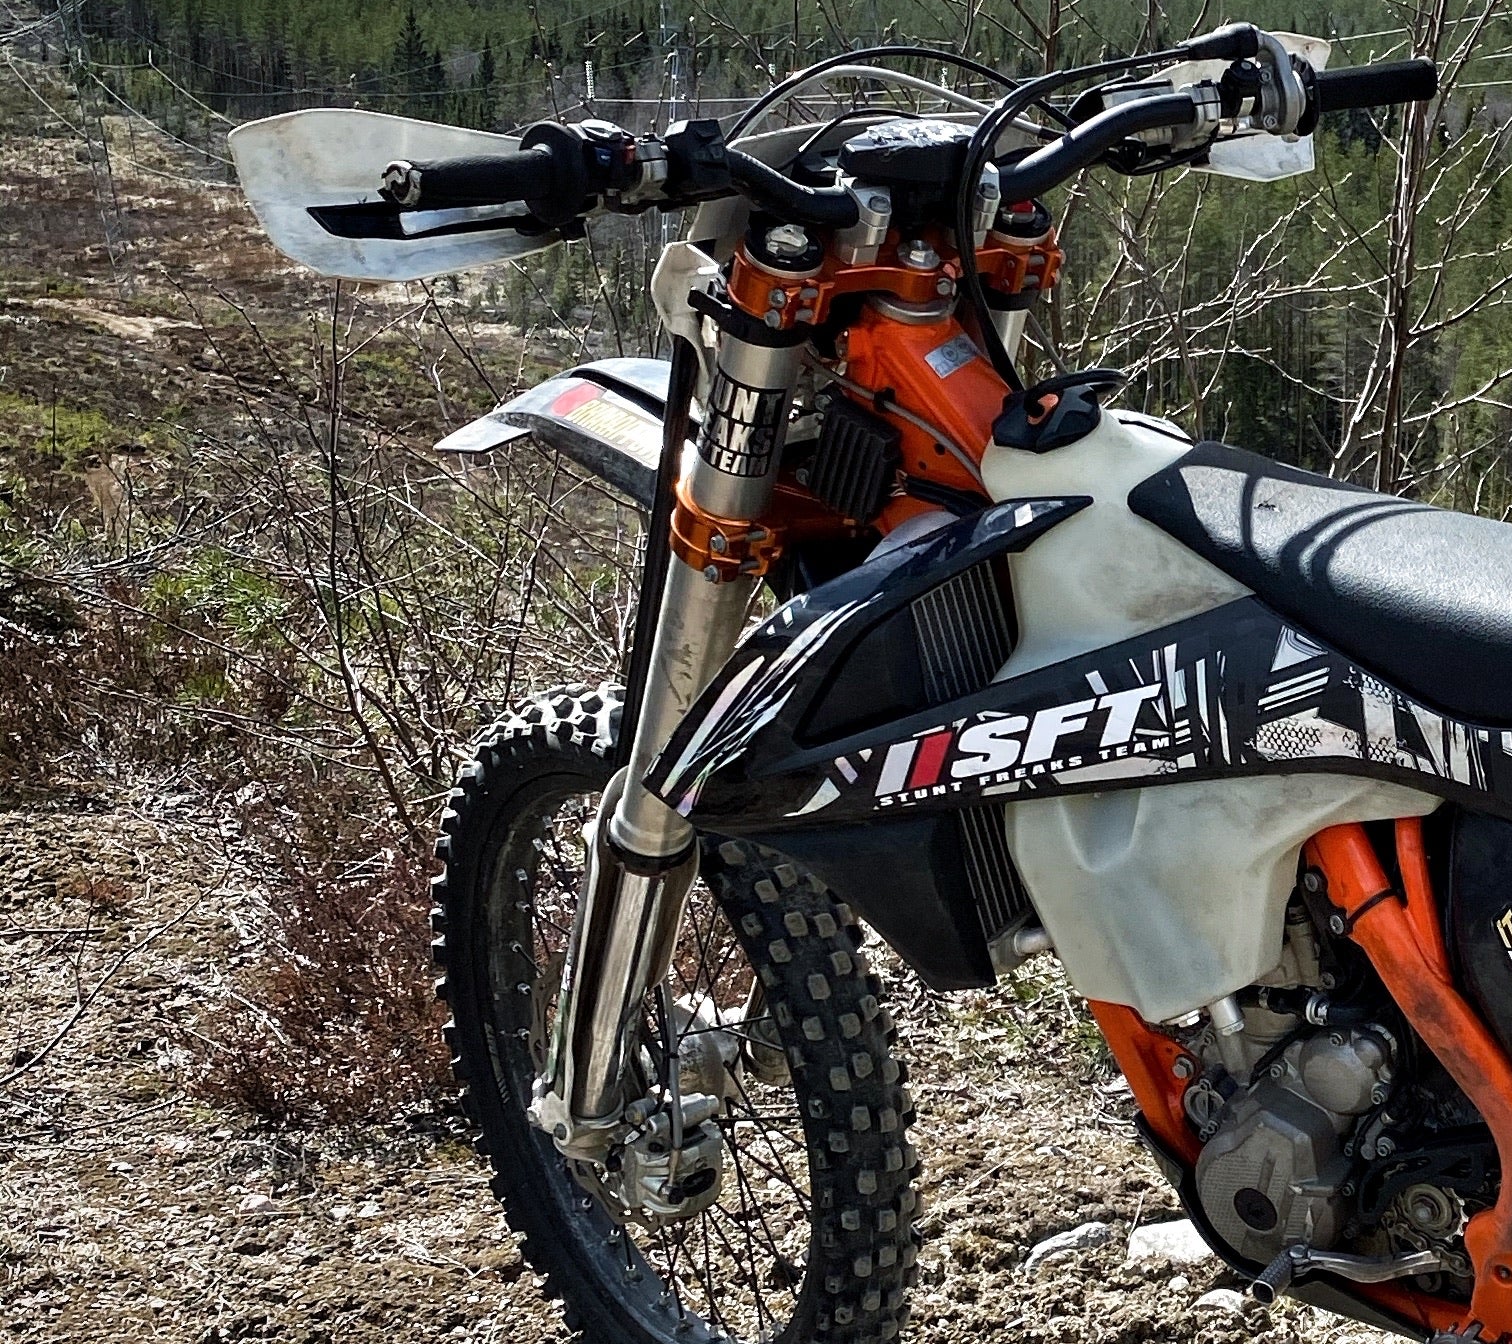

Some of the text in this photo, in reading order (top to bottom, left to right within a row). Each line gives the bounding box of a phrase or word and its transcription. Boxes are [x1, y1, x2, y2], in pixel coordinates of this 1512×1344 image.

[714, 373, 784, 424] UNT
[710, 443, 768, 475] TEAM
[950, 682, 1162, 779] SFT
[879, 737, 1170, 808] STUNT FREAKS TEAM
